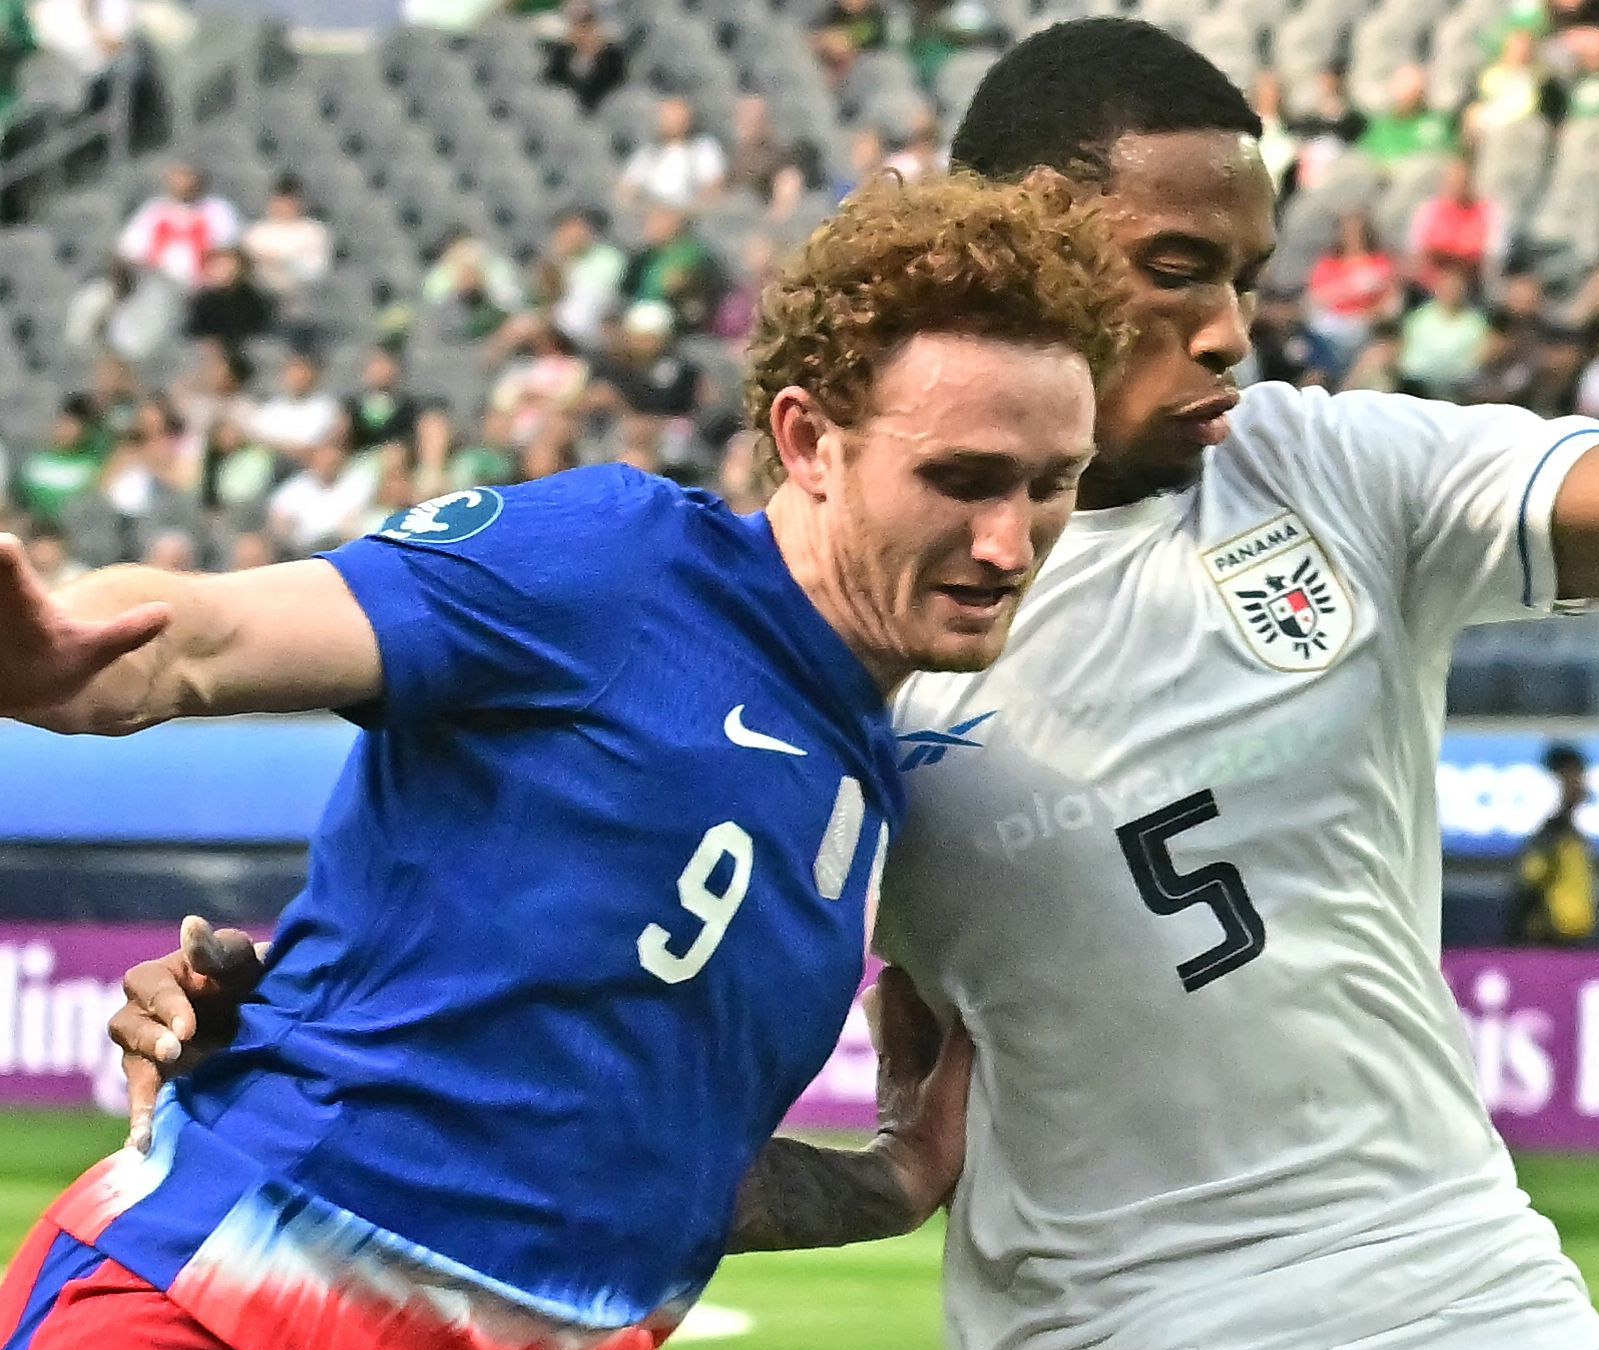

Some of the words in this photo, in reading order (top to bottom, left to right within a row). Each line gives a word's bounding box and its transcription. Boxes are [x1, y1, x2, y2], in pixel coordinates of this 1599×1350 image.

[1213, 523, 1299, 572] PANAMA
[636, 820, 754, 986] 9
[1115, 788, 1266, 993] 5
[1462, 969, 1554, 1115] is
